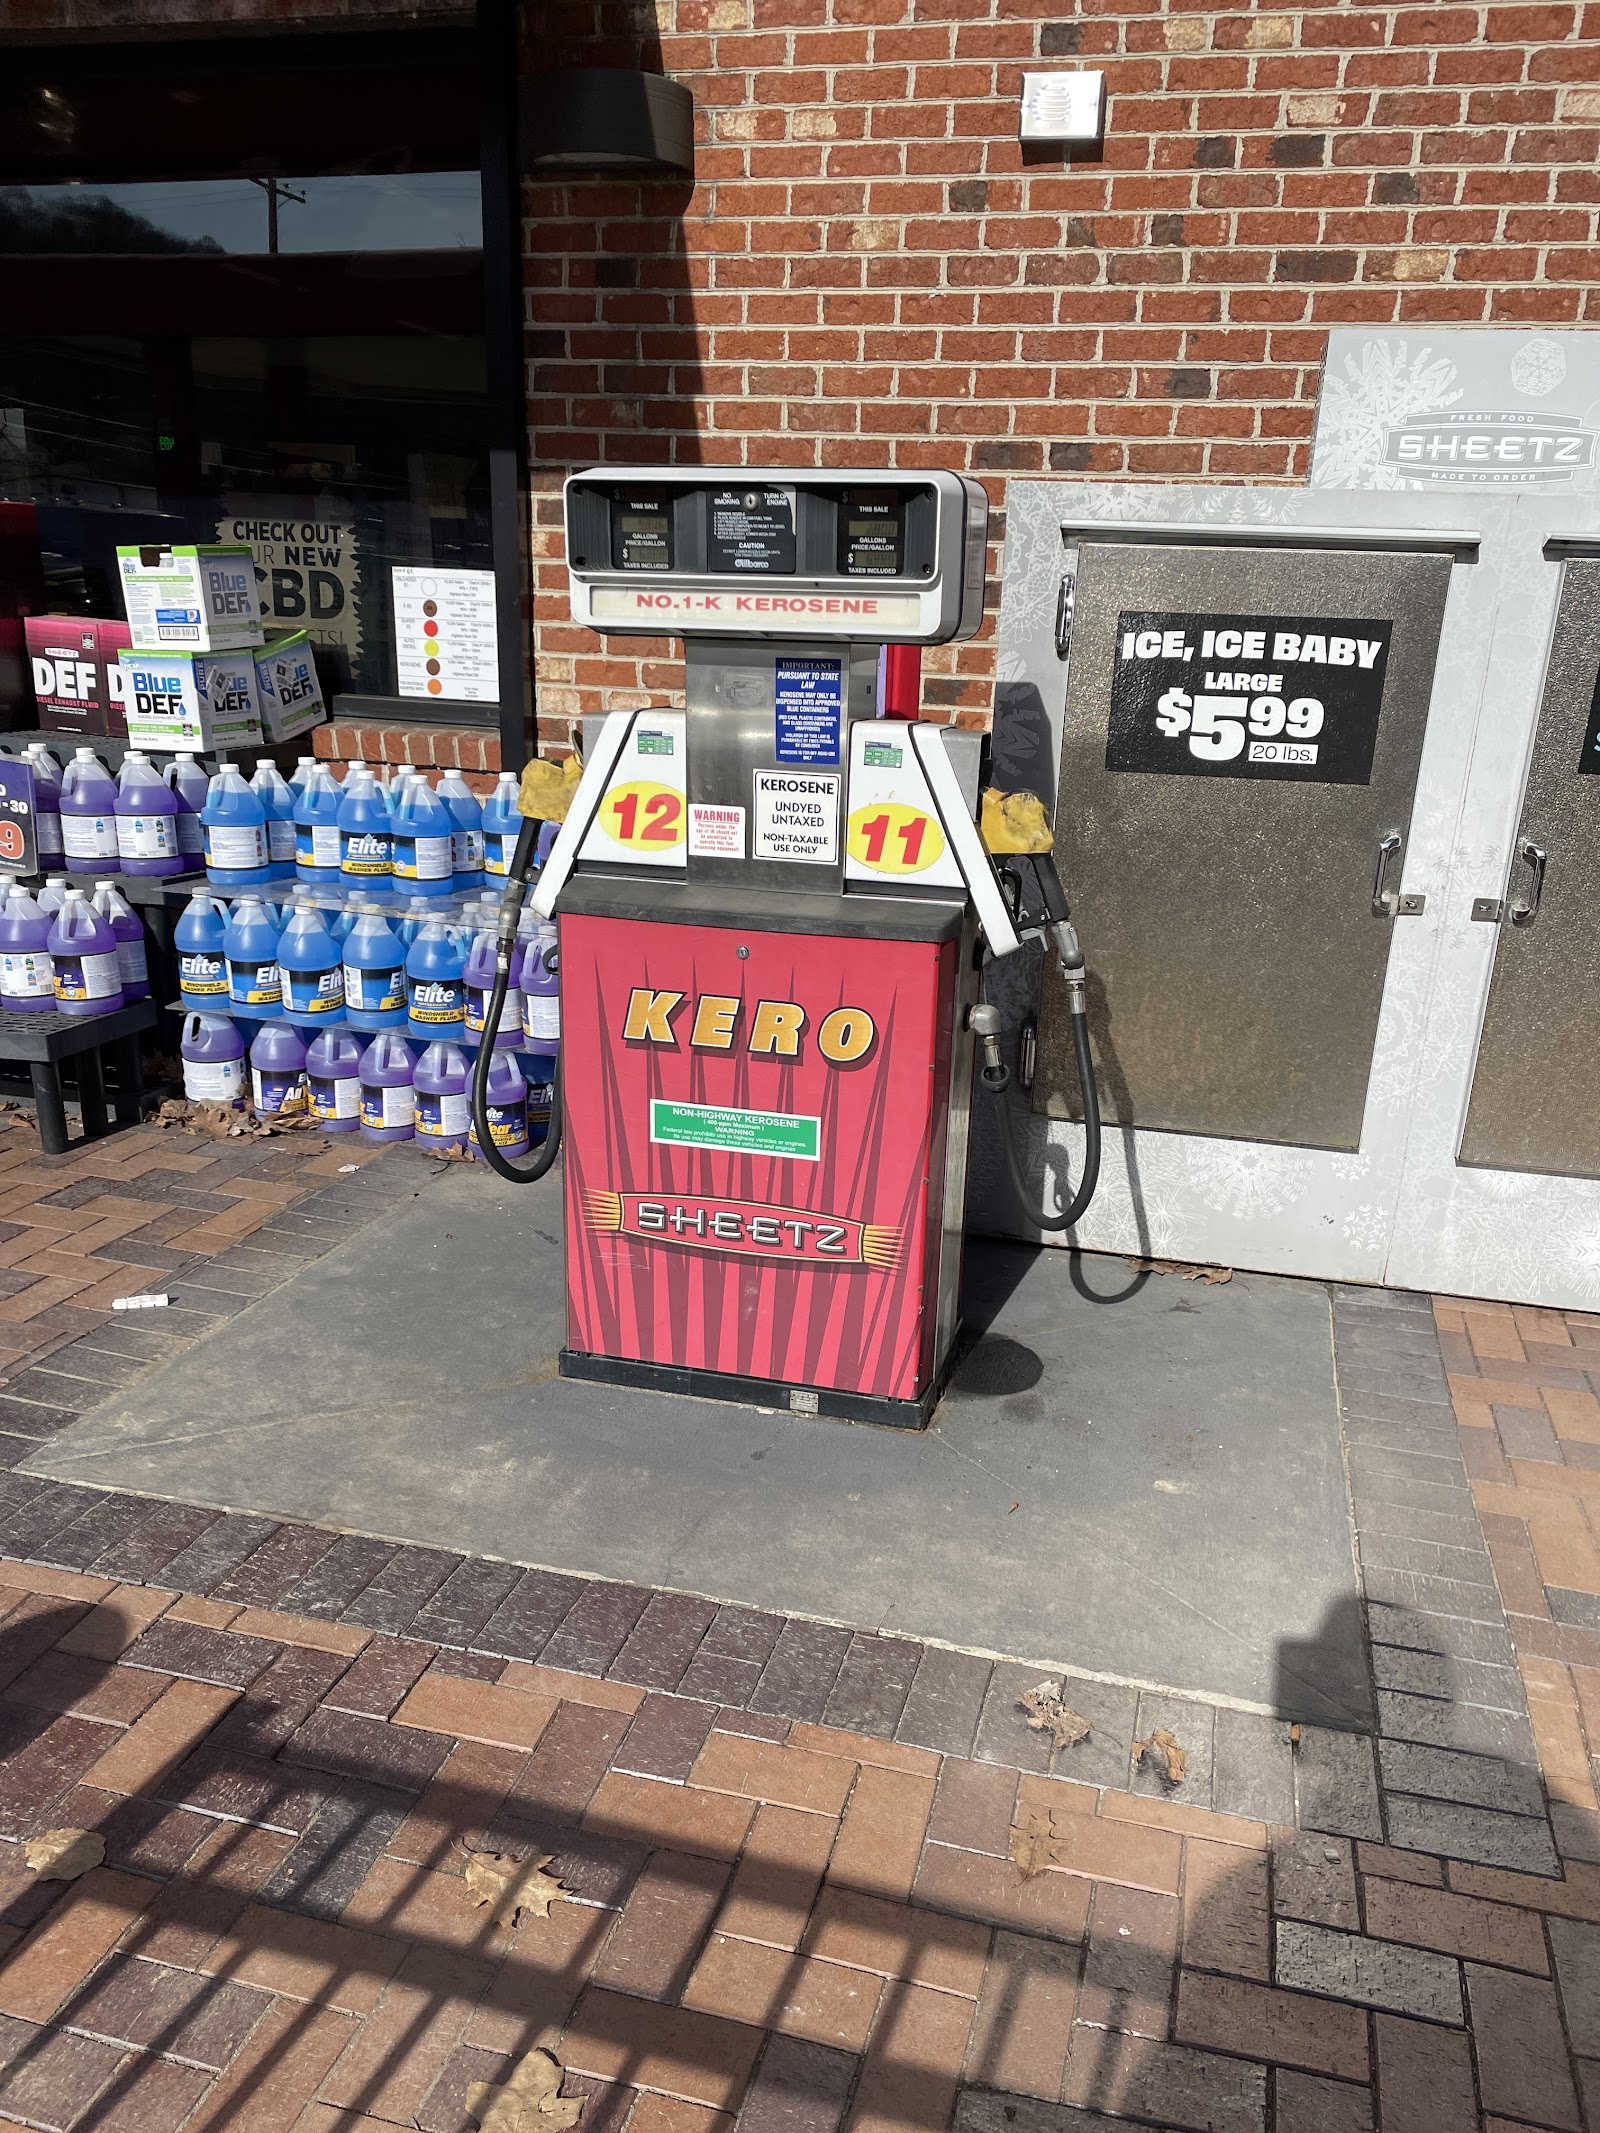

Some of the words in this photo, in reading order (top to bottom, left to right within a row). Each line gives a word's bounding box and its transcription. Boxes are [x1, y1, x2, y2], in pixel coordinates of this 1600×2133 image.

[1450, 413, 1492, 422] FRESH
[1501, 414, 1535, 423] FOOD
[1397, 434, 1585, 463] SHEETZ
[1431, 472, 1465, 481] MADE
[1471, 473, 1489, 481] TO
[1493, 473, 1536, 481] ORDER
[714, 498, 740, 506] SMOKING
[233, 520, 296, 542] CHECK
[300, 524, 342, 544] OUT
[284, 546, 342, 568] NEW
[622, 548, 628, 560] $
[848, 552, 854, 564] $
[734, 558, 769, 569] Gilbarco
[208, 572, 247, 592] Blue
[211, 592, 248, 614] DEF
[636, 594, 721, 611] NO.1-K
[736, 597, 878, 614] KEROSENE
[1121, 630, 1194, 662] ICE,
[1200, 630, 1266, 659] ICE
[1272, 632, 1382, 670] BABY
[32, 658, 97, 700] DEF
[132, 672, 182, 693] Blue
[778, 672, 810, 680] PURSUANT
[1204, 672, 1284, 692] LARGE
[279, 678, 310, 705] DEF
[801, 681, 815, 689] LAW
[54, 698, 80, 707] EXHAUST
[135, 693, 182, 715] DEF
[1252, 745, 1278, 760] 20
[1282, 745, 1314, 762] lbs.
[761, 778, 834, 794] KEROSENE
[694, 809, 740, 822] WARNING
[776, 802, 822, 814] UNDYED
[613, 793, 682, 842] 12
[772, 814, 824, 827] UNTAXED
[348, 837, 388, 854] Elite
[763, 833, 828, 844] NON-TAXABLE
[861, 814, 927, 865] 11
[793, 846, 818, 854] ONLY
[182, 957, 221, 974] Elite
[256, 966, 280, 984] Eli
[318, 970, 343, 992] Elit
[414, 984, 455, 1003] Elite
[622, 987, 879, 1063] KERO
[486, 1109, 504, 1118] lite
[672, 1107, 742, 1122] NON-HIGHWAY
[745, 1115, 800, 1128] KEROSENE
[715, 1127, 754, 1136] WARNING
[733, 1134, 754, 1142] highway
[638, 1202, 846, 1253] SHEETZ
